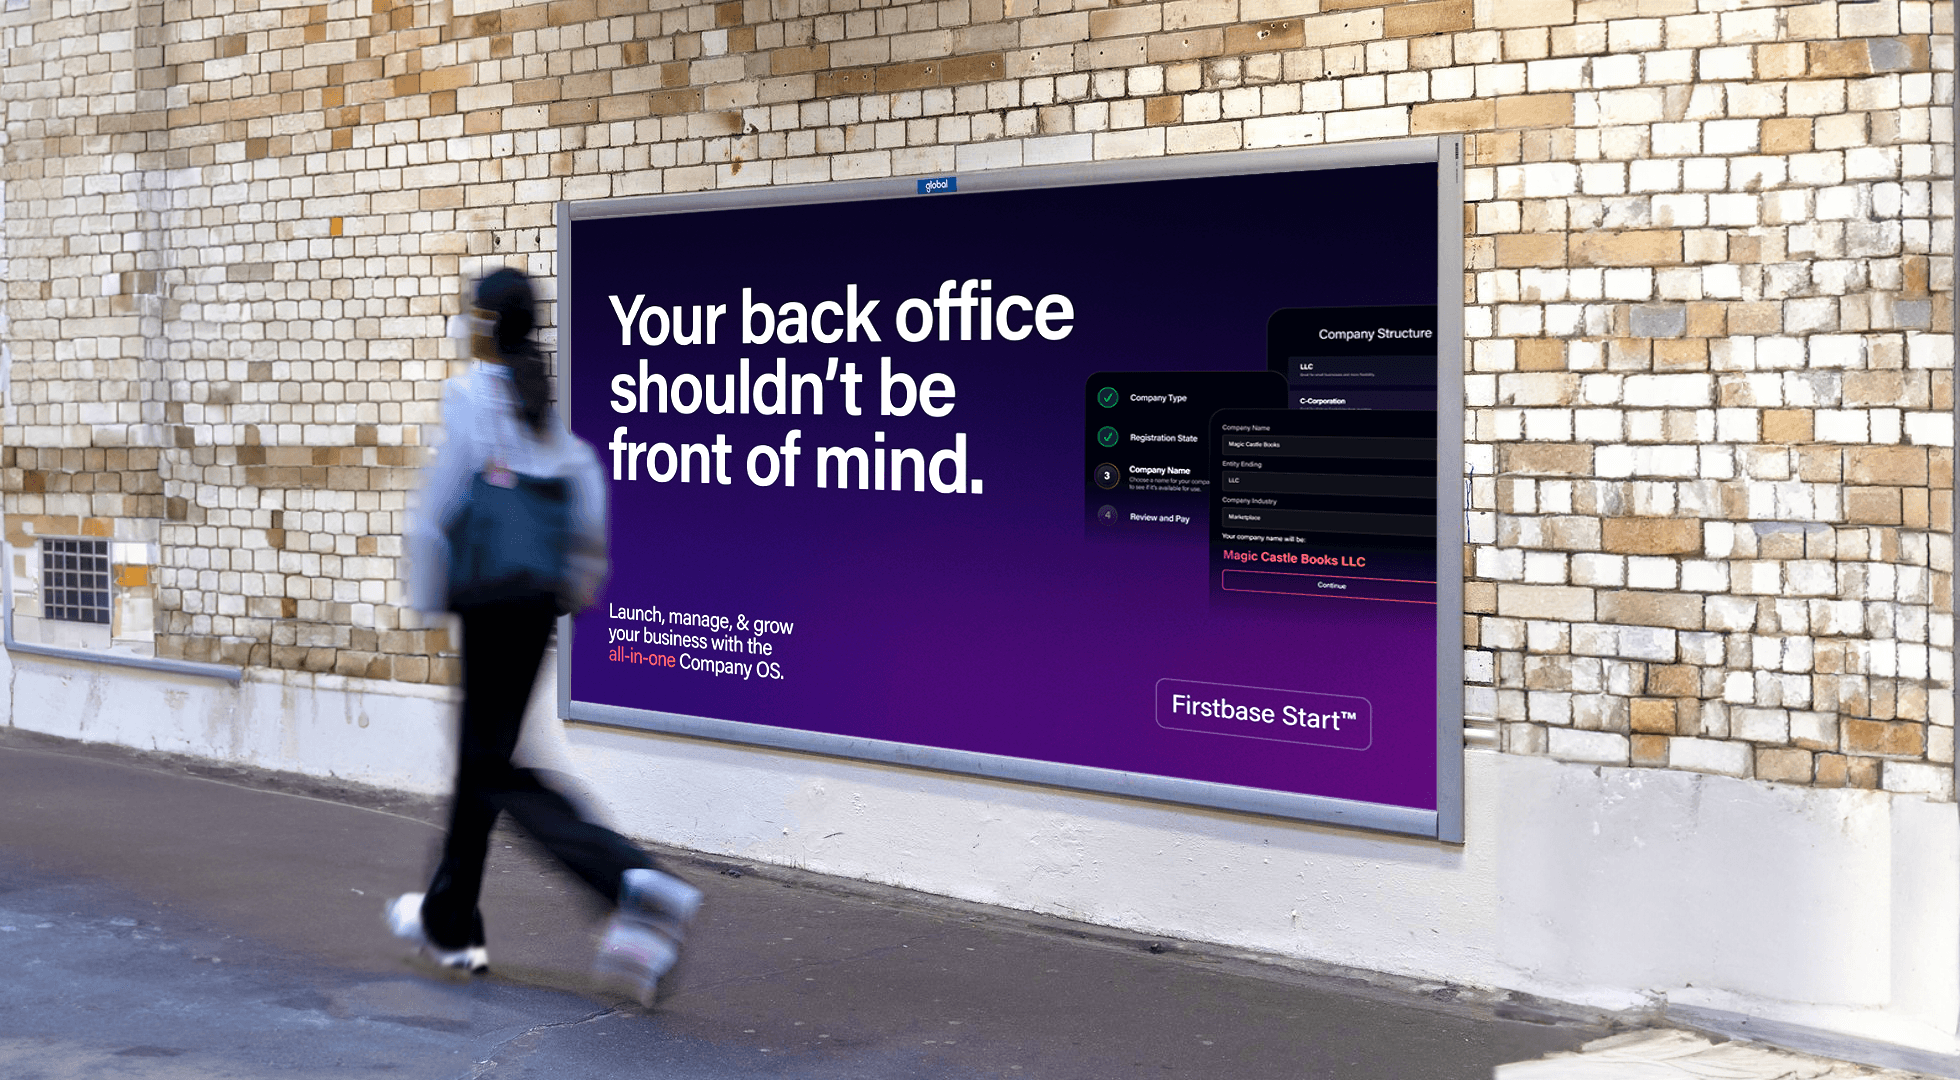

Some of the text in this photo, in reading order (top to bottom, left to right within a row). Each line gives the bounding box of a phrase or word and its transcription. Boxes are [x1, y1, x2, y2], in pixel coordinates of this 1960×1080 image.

[925, 178, 948, 193] global
[608, 278, 1075, 346] Your back office
[1319, 327, 1433, 342] Company Structure
[610, 356, 956, 418] shouldn’t be
[1129, 393, 1188, 403] Company Type
[1299, 397, 1346, 405] C-Corporation
[1221, 424, 1251, 432] Company
[1129, 433, 1198, 443] Registration State
[609, 426, 983, 495] front of mind.
[1222, 460, 1263, 469] Entity Ending
[1103, 471, 1110, 480] 3
[1129, 465, 1191, 476] Company Name
[1221, 496, 1278, 506] Company Industry
[1104, 511, 1111, 519] 4
[1129, 513, 1190, 525] Review and Pay
[1228, 513, 1261, 521] Marketplace
[1236, 534, 1265, 542] company
[1223, 549, 1366, 567] Magic Castle Books LLC
[1317, 581, 1347, 590] Continue
[609, 602, 794, 637] Launch, manage, & grow
[608, 627, 773, 656] your business with the
[608, 645, 785, 680] all-in-one Company OS.
[1172, 694, 1275, 724] Firstbase
